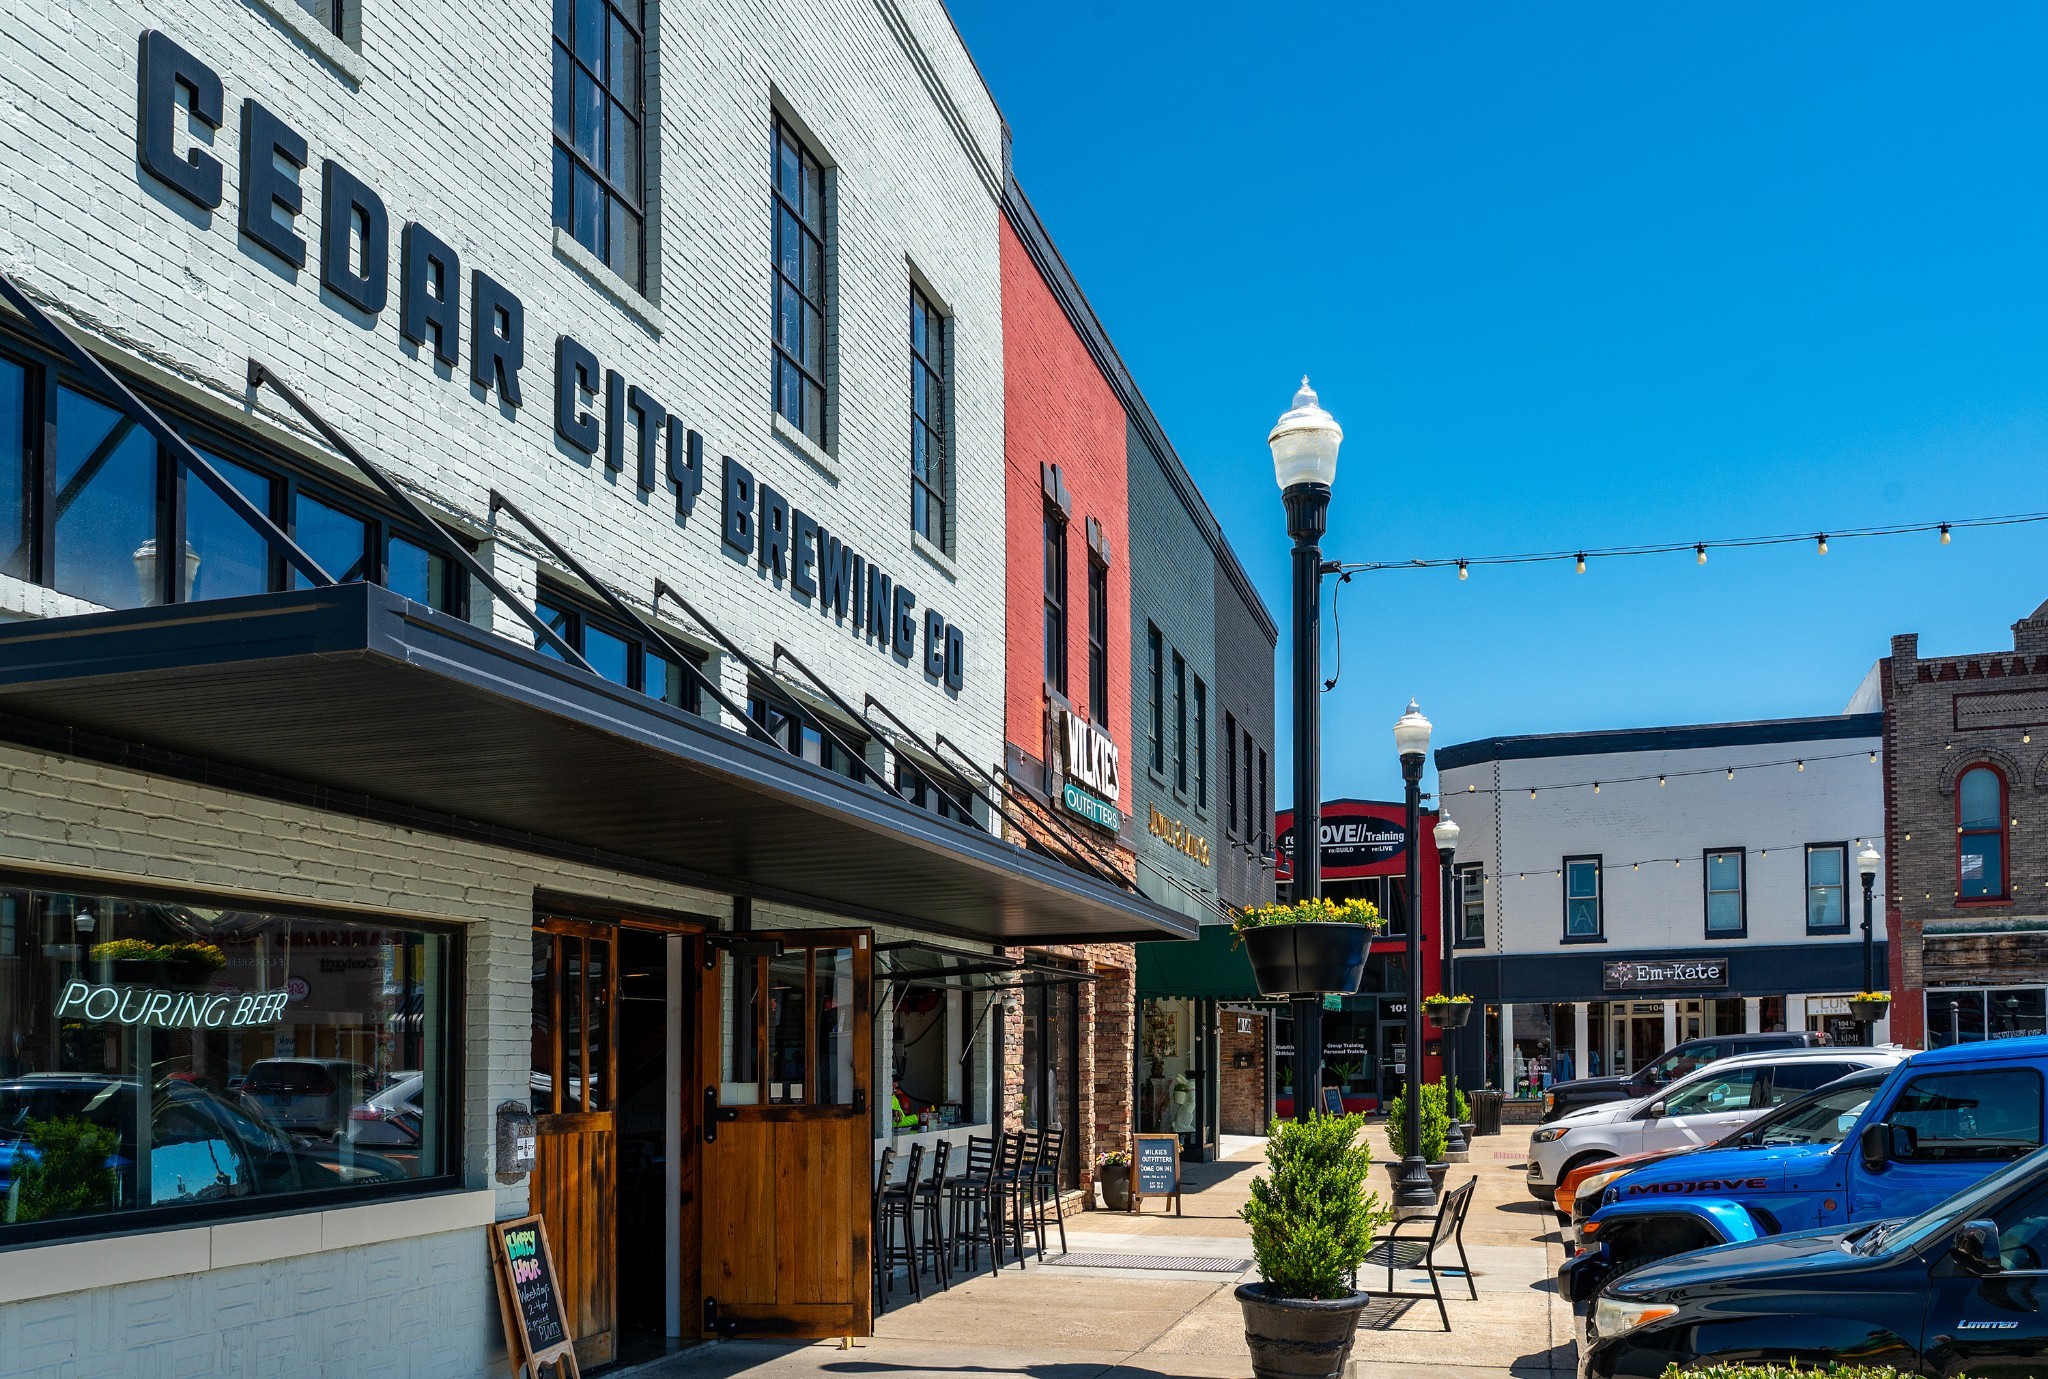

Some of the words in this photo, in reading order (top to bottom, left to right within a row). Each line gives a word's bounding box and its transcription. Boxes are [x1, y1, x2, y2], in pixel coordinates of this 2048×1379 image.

[137, 29, 525, 408] CEDAR
[555, 334, 704, 517] CITY
[721, 455, 917, 660] BREWING
[924, 608, 964, 692] CO
[1066, 711, 1120, 801] WILKIES
[1067, 789, 1118, 829] OUTFITTERS
[59, 983, 231, 1028] POURING
[232, 991, 289, 1026] BEER
[1343, 1042, 1365, 1050] Training
[1628, 1178, 1768, 1195] MOJAVE
[512, 1258, 542, 1283] HOUR
